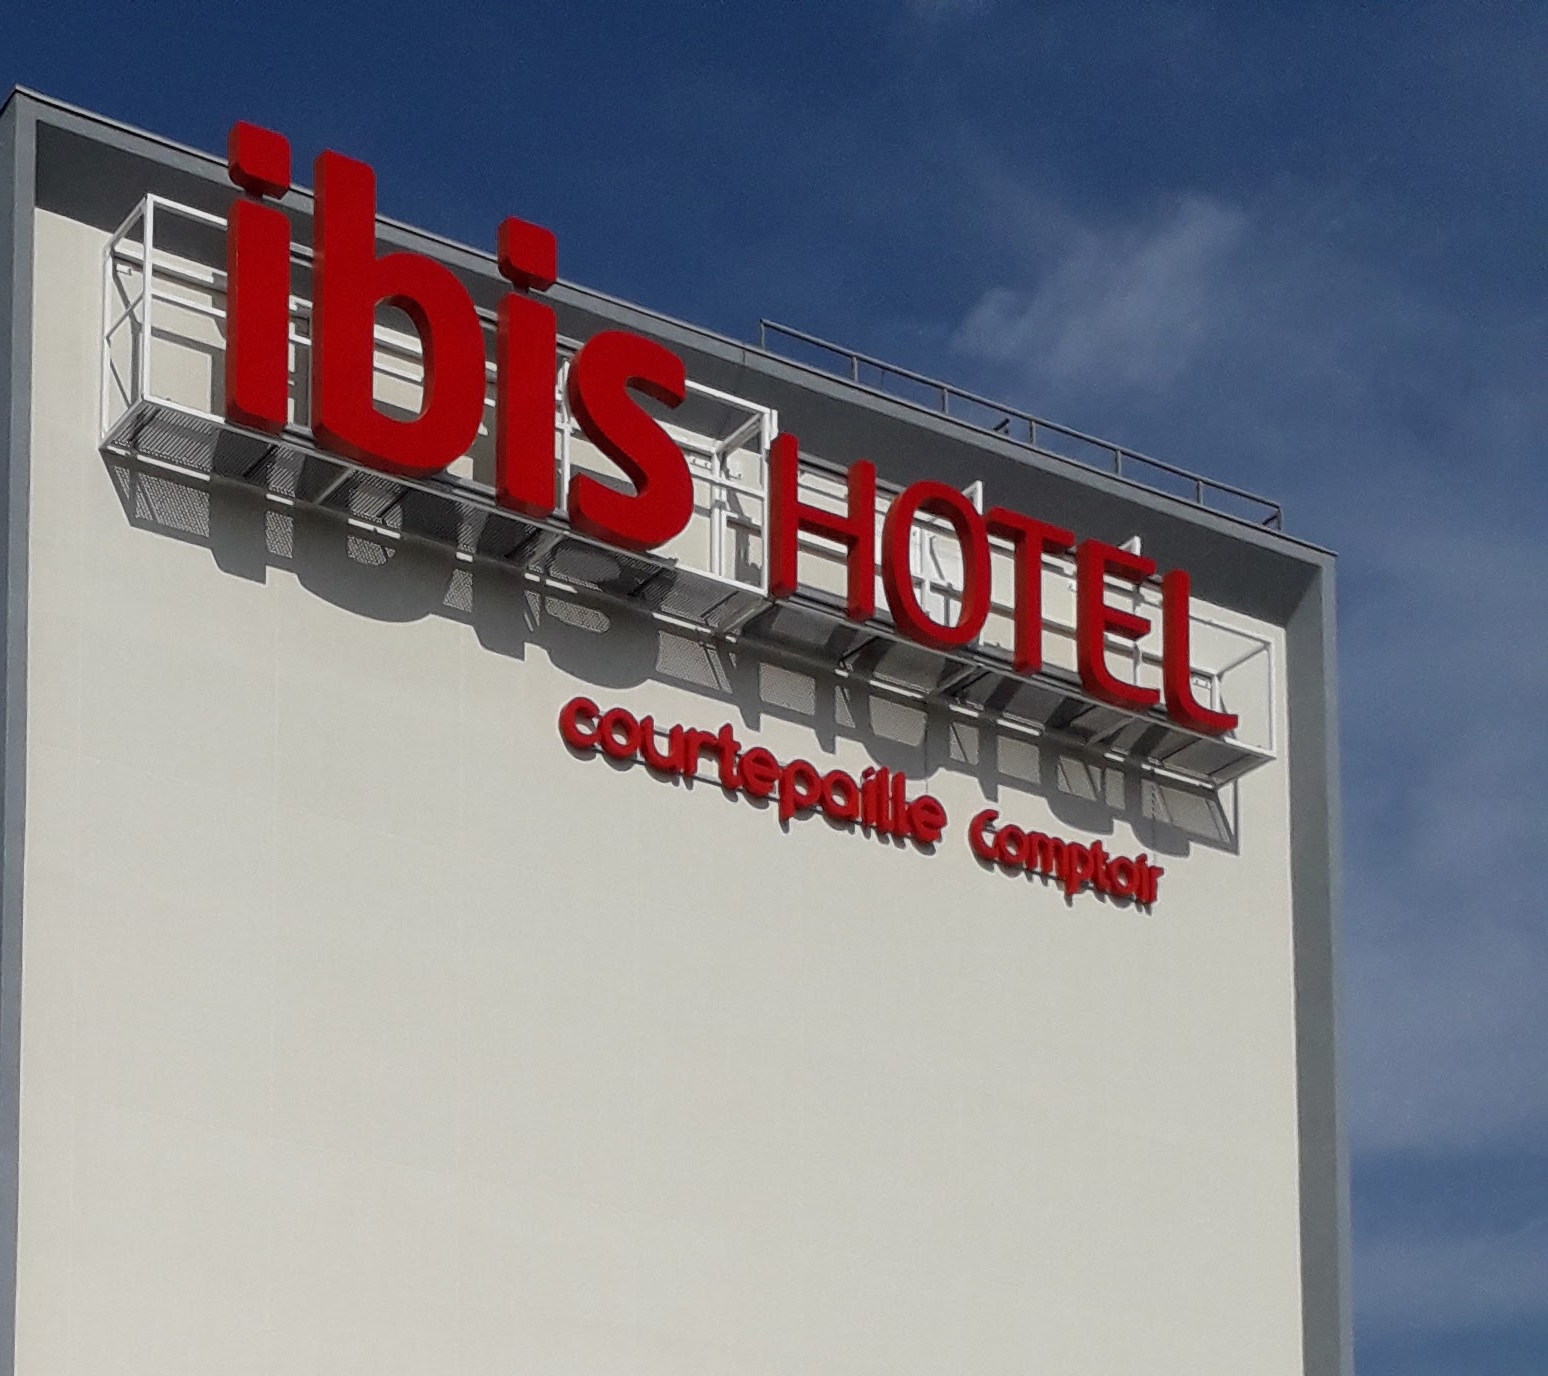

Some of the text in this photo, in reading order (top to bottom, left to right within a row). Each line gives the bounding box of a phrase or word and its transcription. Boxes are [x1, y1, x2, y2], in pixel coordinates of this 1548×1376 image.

[226, 121, 1238, 731] ibis HOTEL
[558, 697, 1164, 905] courtepaille Comptoir
